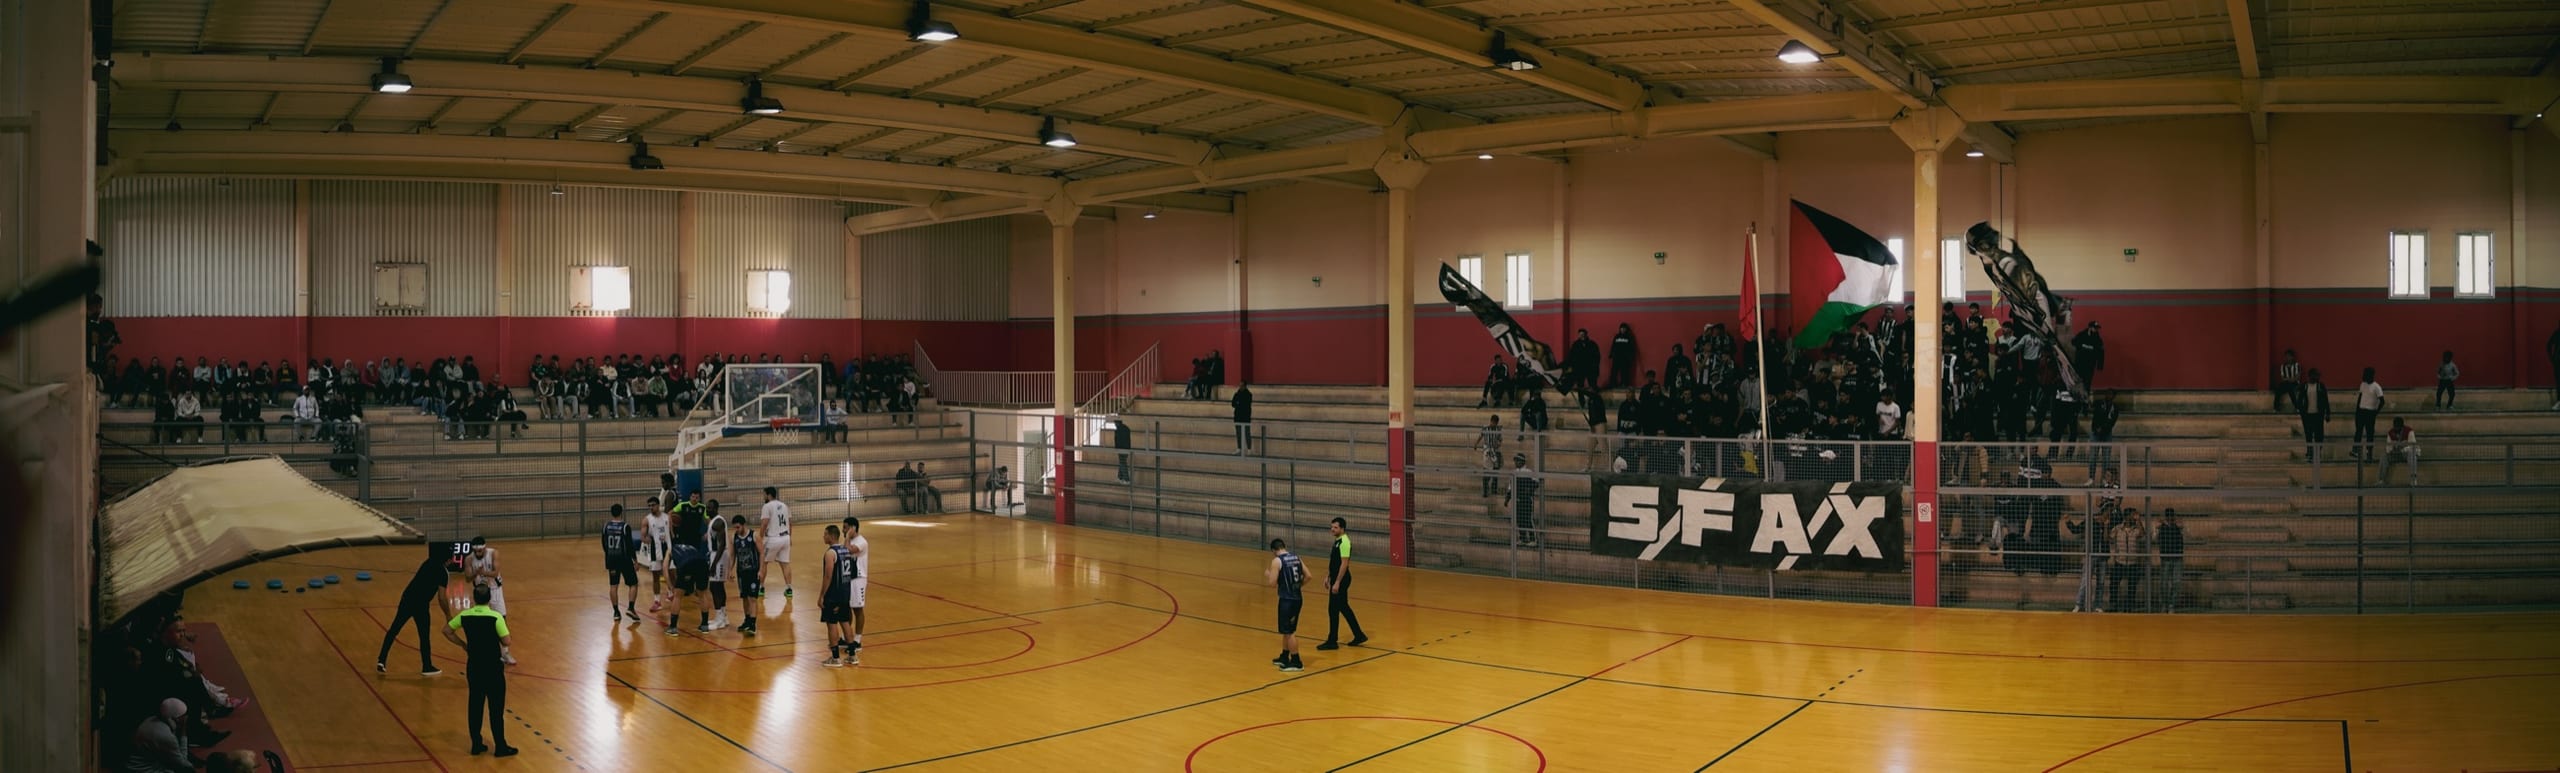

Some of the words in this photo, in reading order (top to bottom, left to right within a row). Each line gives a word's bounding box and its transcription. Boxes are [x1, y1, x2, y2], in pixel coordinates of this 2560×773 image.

[777, 513, 787, 527] 14
[454, 543, 470, 554] 30
[608, 535, 621, 549] 07
[1292, 566, 1299, 582] 5
